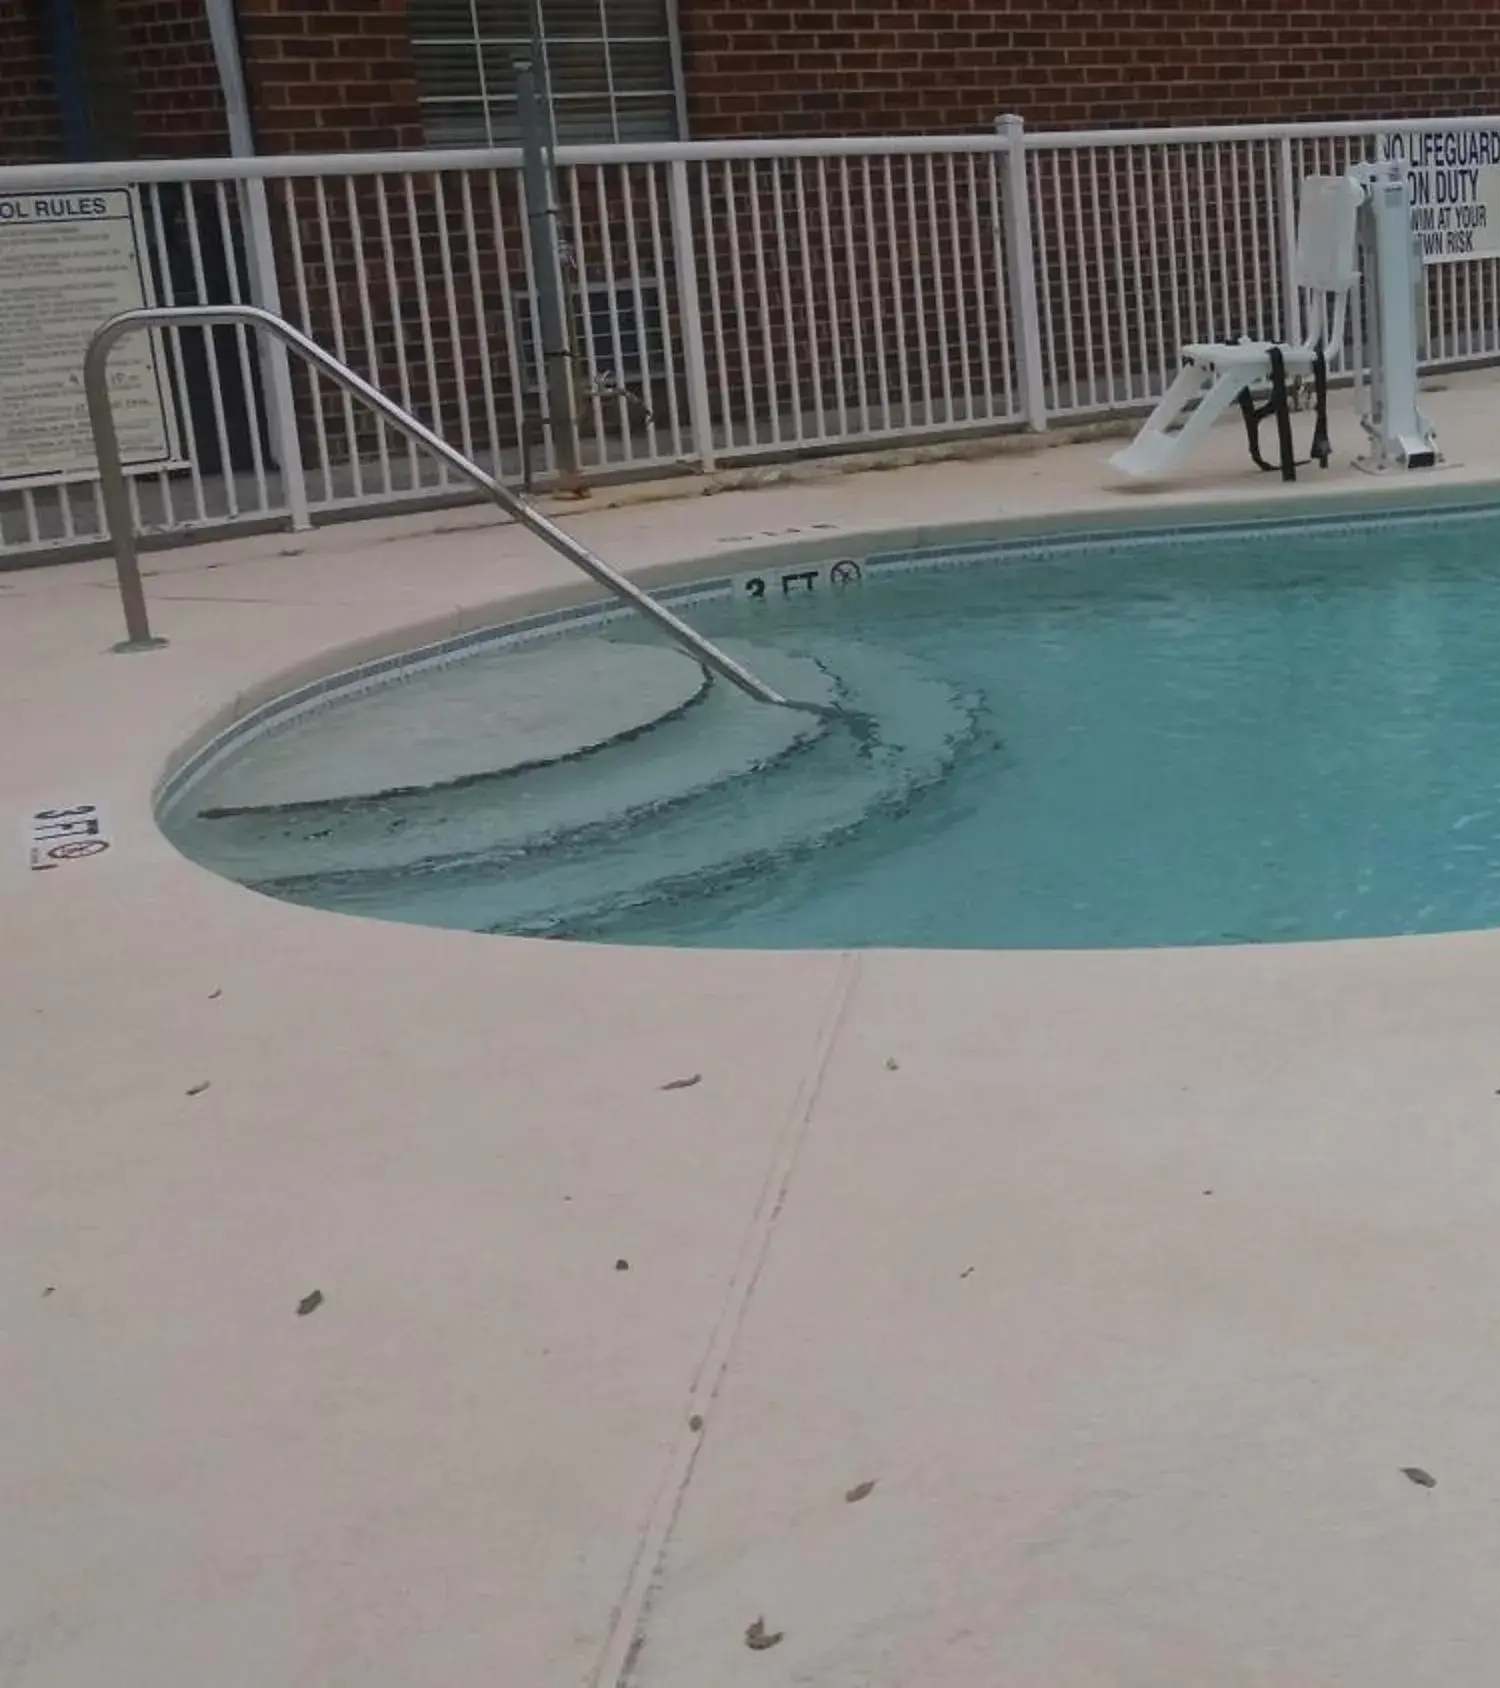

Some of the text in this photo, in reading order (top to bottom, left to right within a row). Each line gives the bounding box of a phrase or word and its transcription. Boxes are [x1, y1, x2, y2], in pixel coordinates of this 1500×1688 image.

[1435, 169, 1479, 204] DUTY
[35, 198, 107, 216] RULES
[1437, 207, 1451, 230] AT
[1455, 205, 1487, 228] YOUR
[1418, 231, 1473, 255] WN RISK
